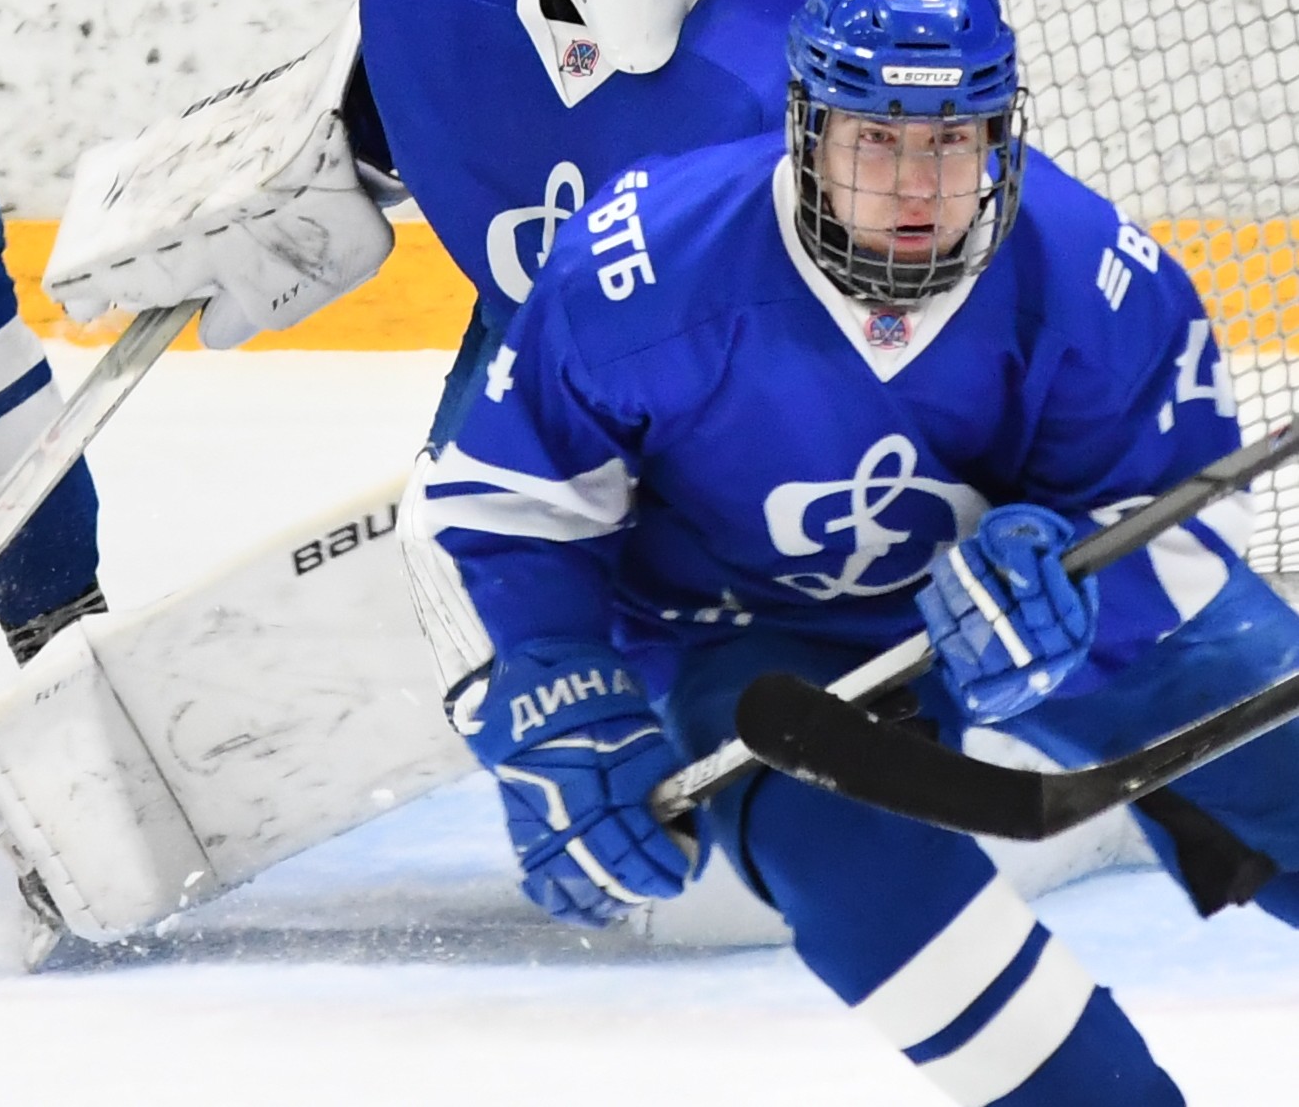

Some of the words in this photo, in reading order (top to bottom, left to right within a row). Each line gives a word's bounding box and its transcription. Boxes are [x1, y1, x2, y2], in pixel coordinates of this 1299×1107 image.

[587, 191, 657, 302] ВТБ
[293, 503, 397, 576] BAU
[509, 668, 638, 743] ДИНА
